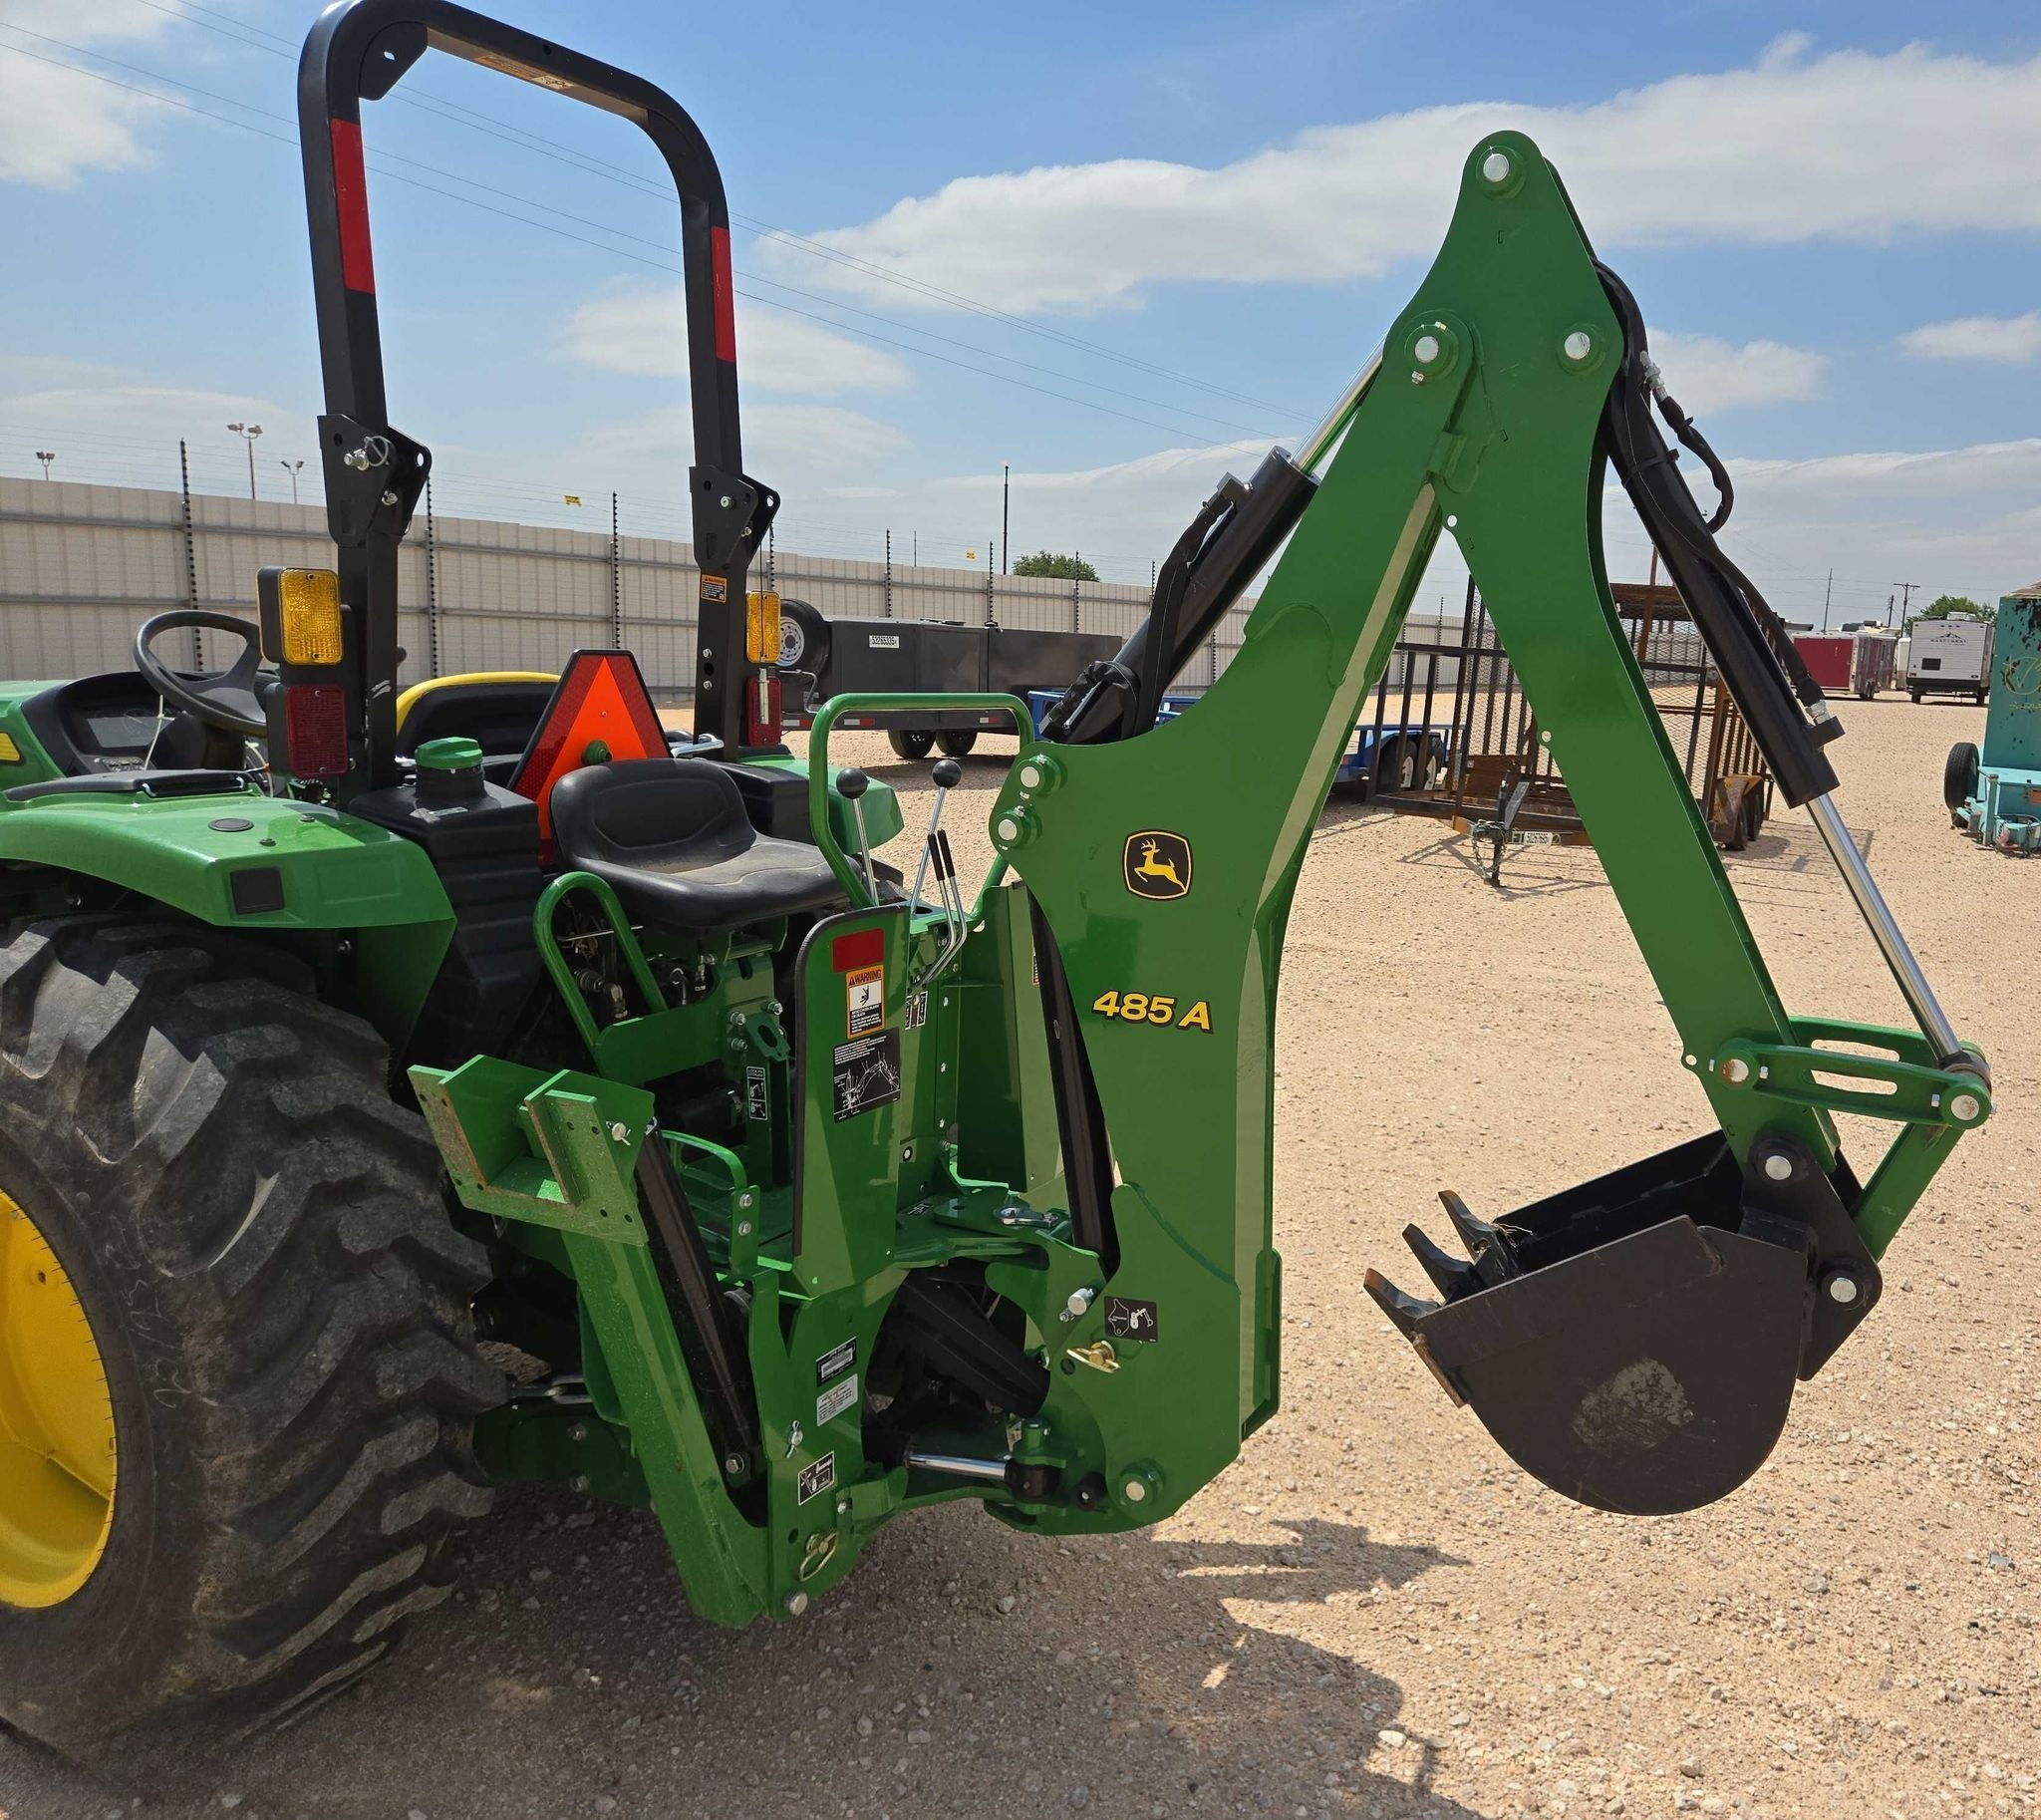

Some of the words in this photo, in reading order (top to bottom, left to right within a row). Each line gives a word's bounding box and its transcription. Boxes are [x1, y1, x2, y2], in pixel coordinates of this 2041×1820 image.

[854, 969, 882, 985] WARNING
[1092, 990, 1176, 1025] 485
[1177, 1000, 1211, 1031] A
